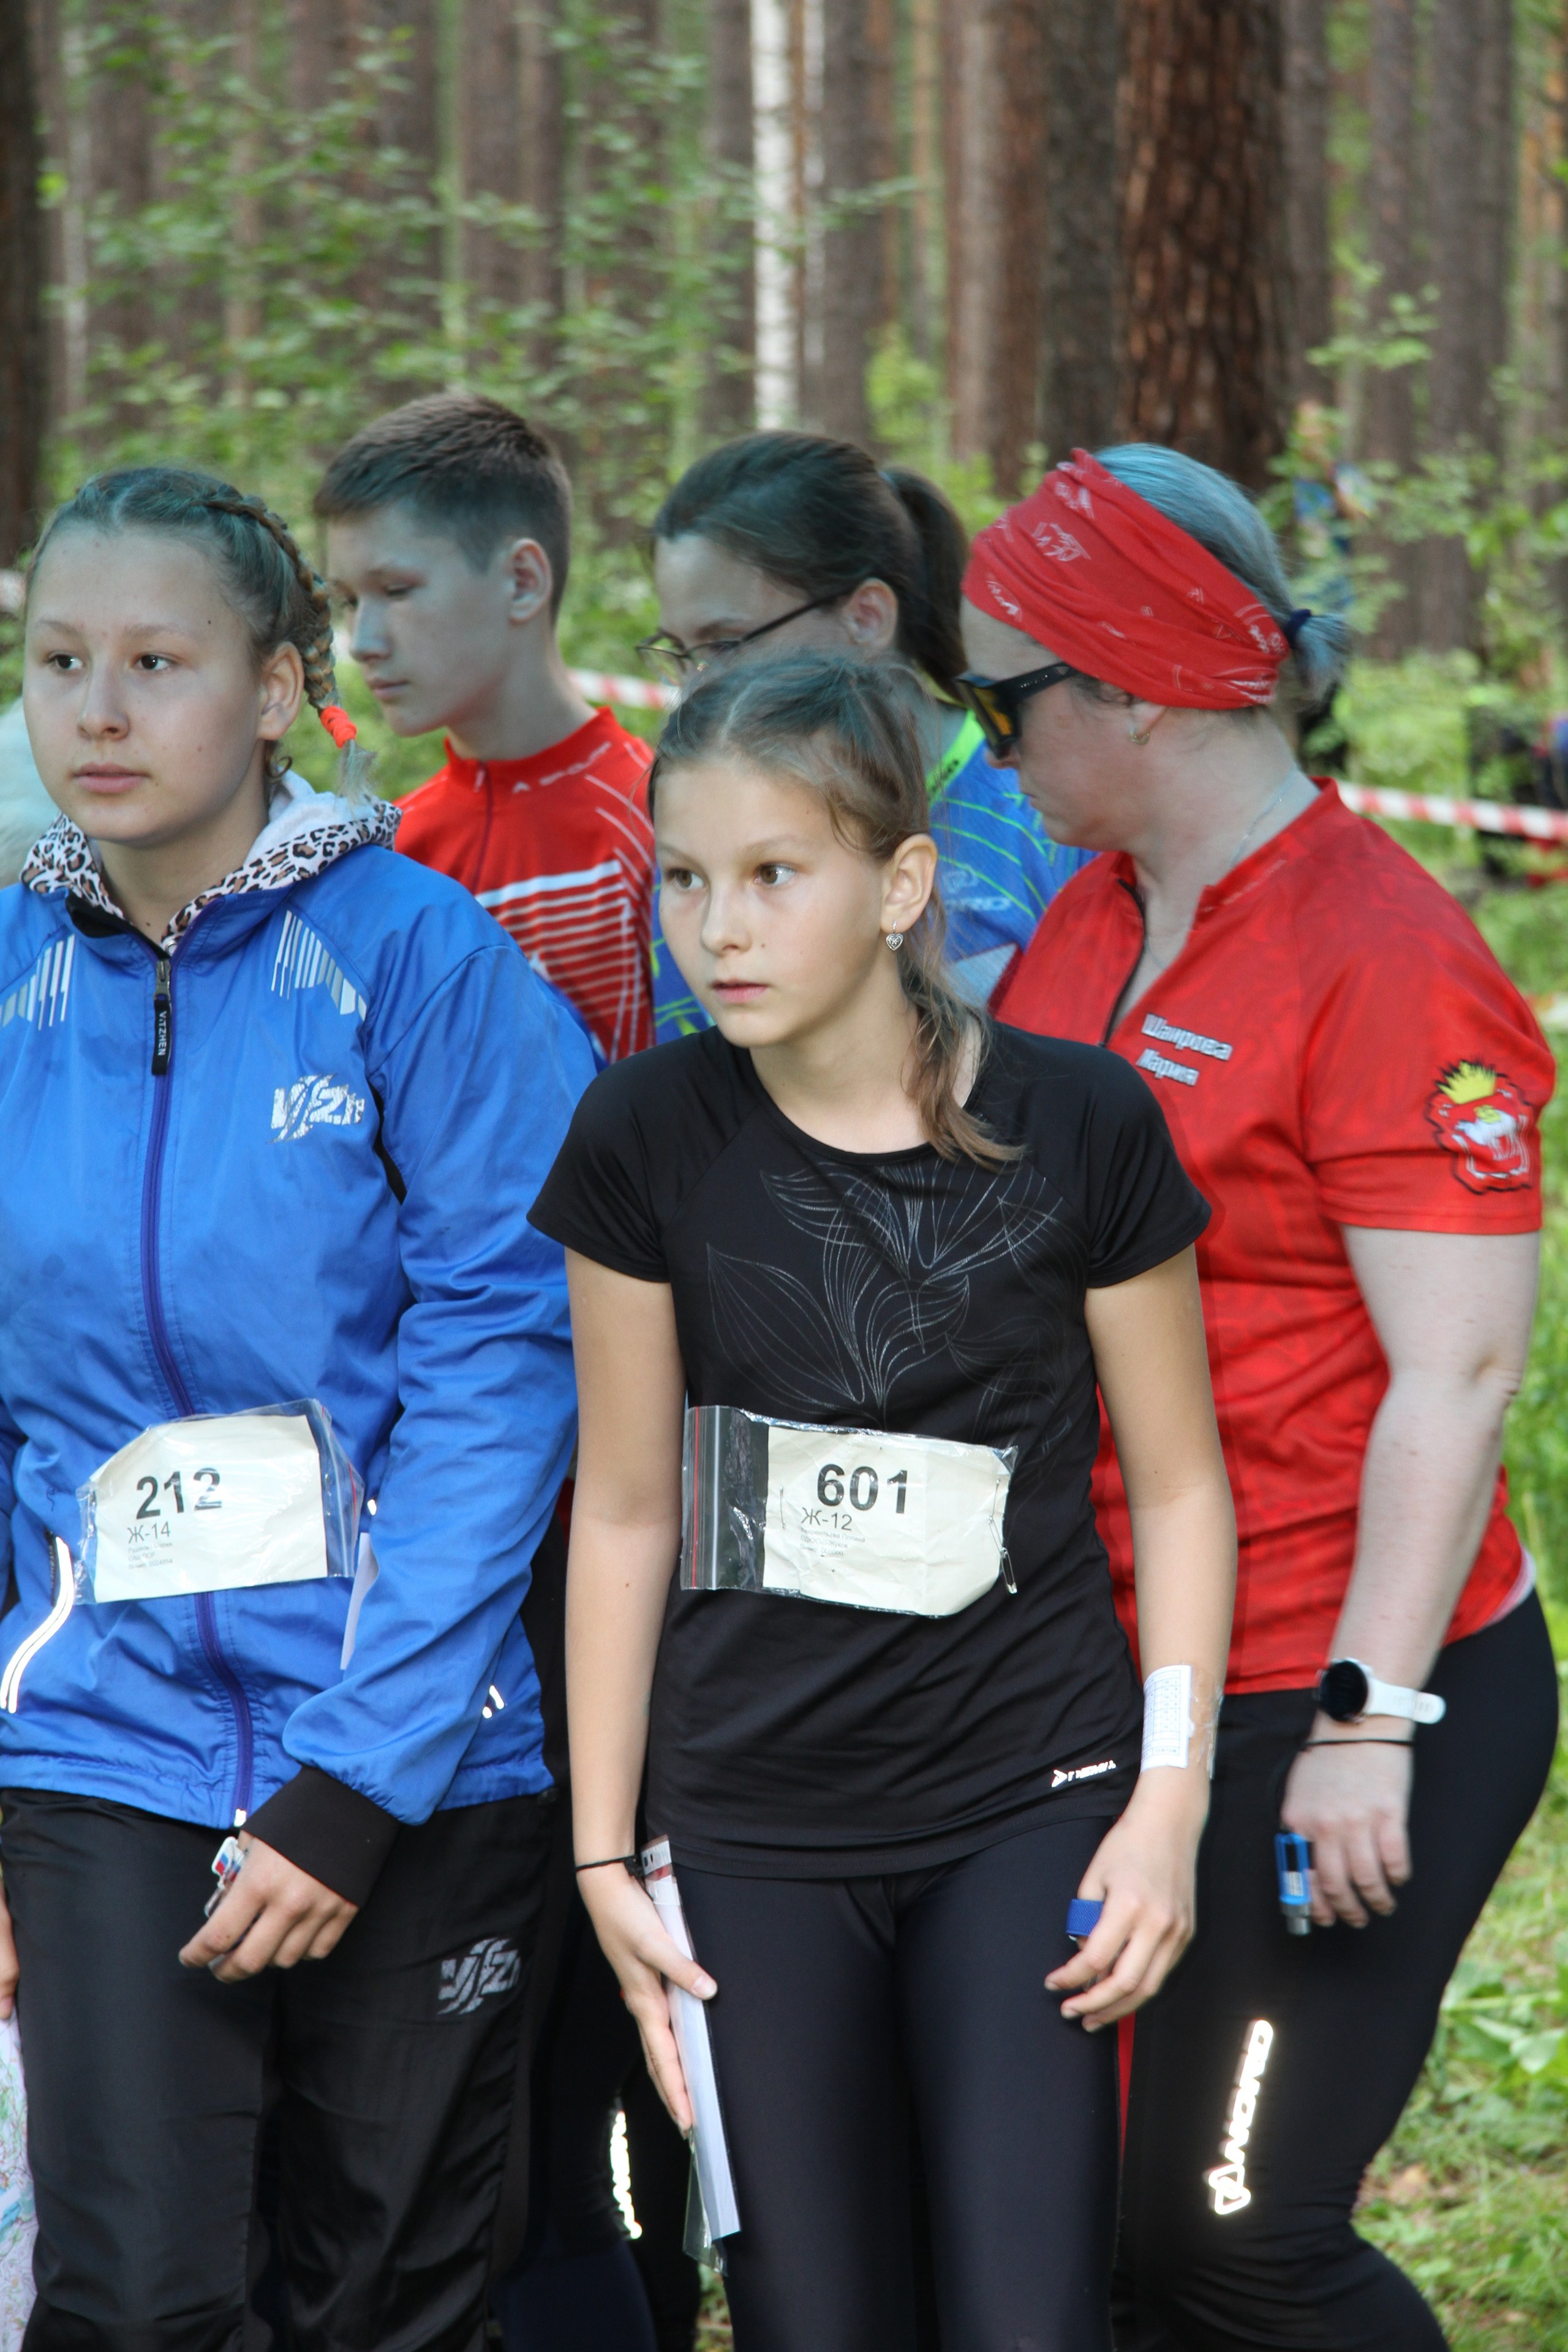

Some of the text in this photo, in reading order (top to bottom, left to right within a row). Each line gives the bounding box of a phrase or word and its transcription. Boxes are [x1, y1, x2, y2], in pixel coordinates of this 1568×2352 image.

[136, 1468, 222, 1520] 212
[817, 1463, 908, 1514] 601
[127, 1521, 171, 1544] Ж-14
[801, 1507, 852, 1531] Ж-12
